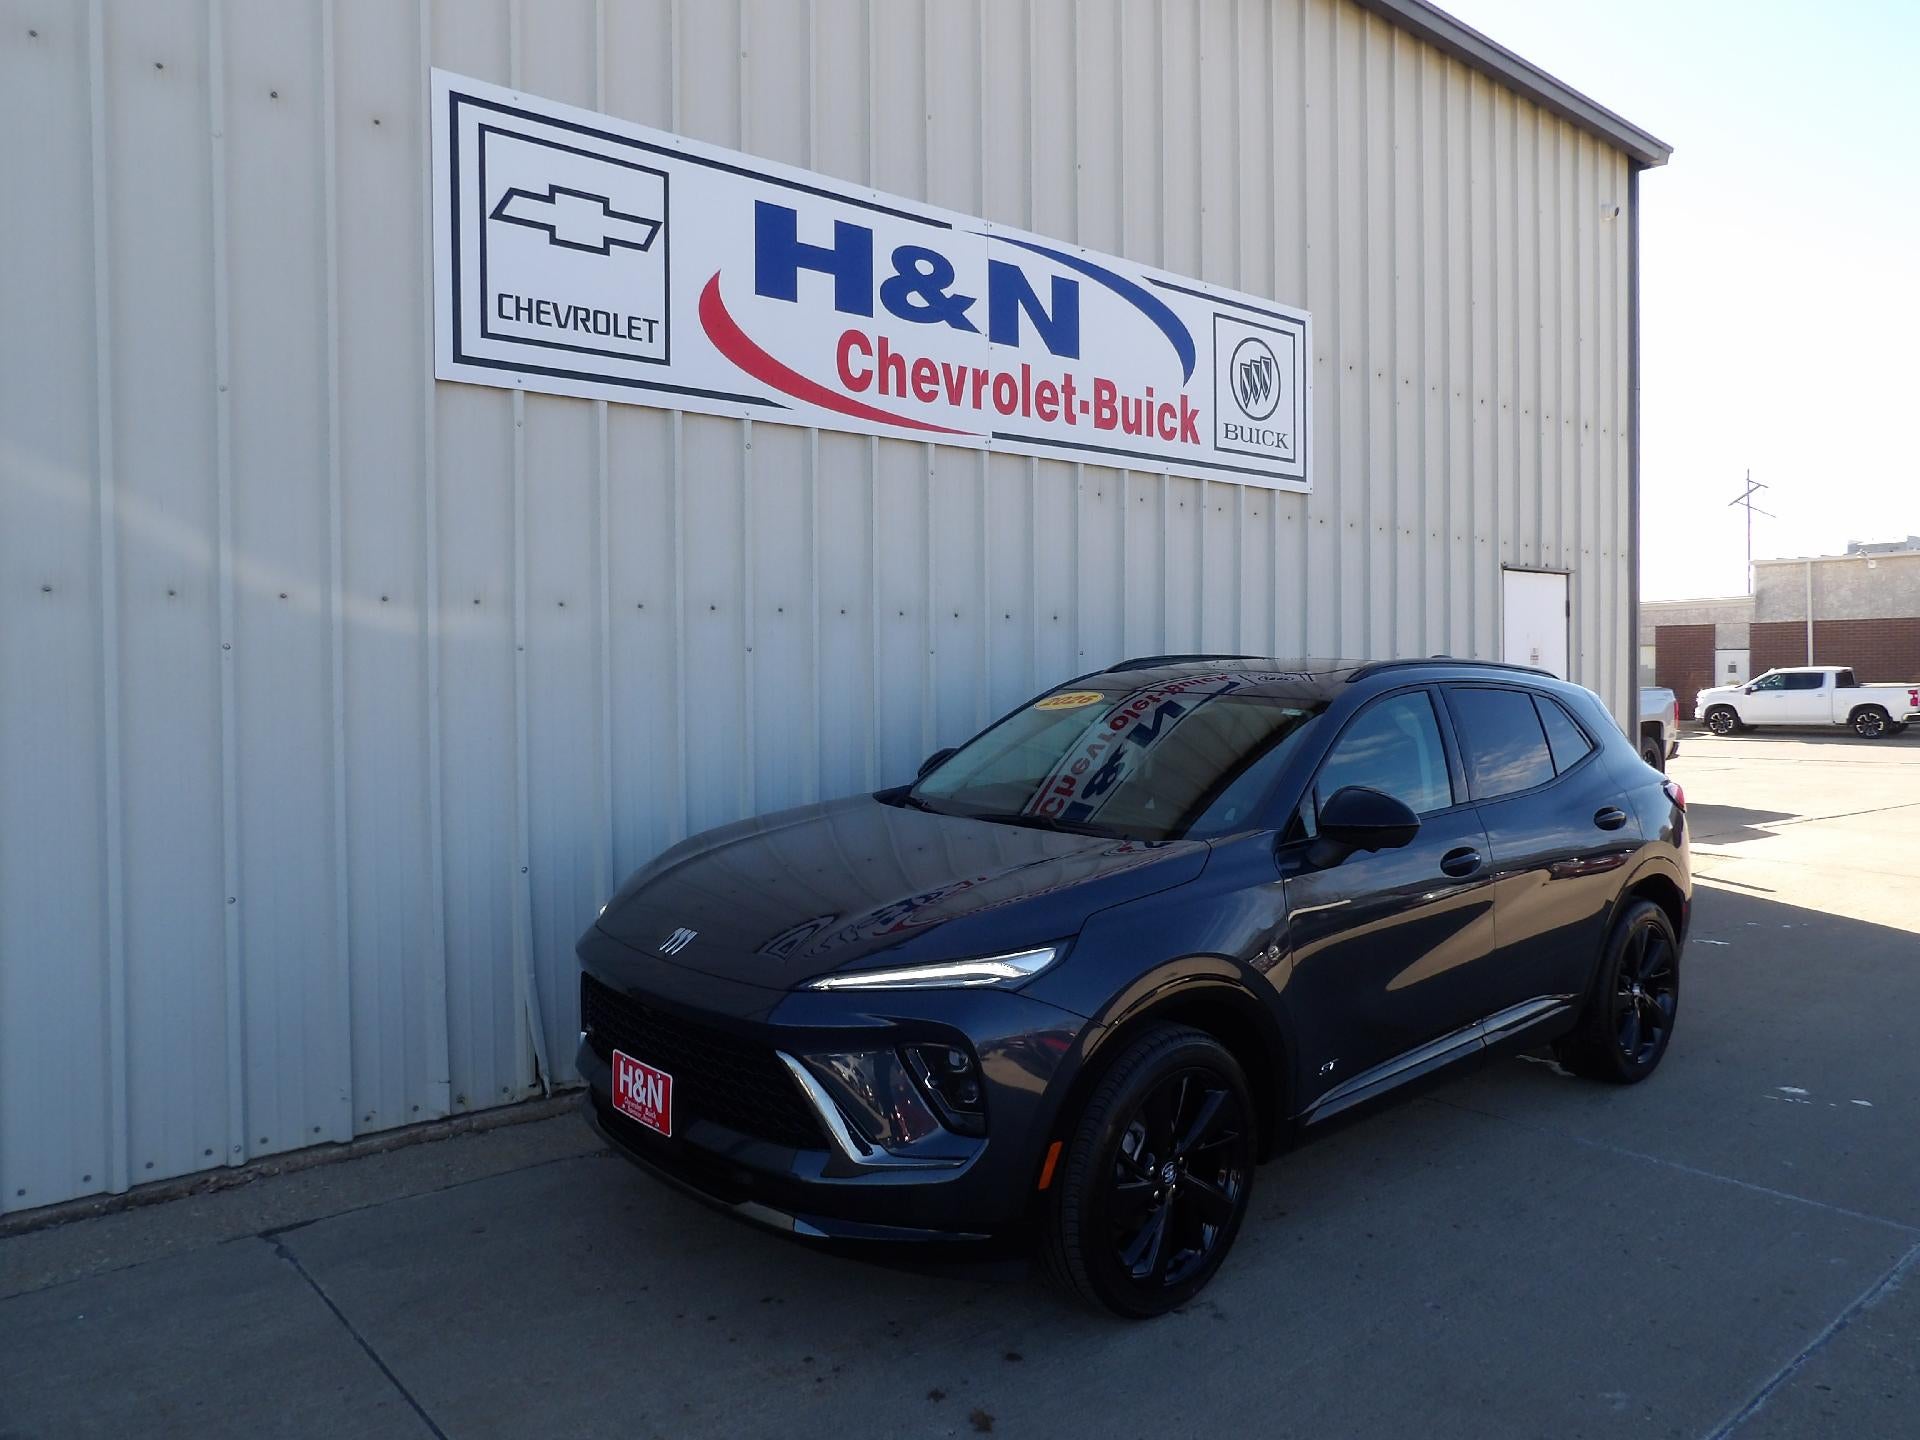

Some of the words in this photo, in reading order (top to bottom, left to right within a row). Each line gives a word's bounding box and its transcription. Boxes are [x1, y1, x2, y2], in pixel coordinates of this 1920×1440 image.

[754, 199, 1080, 360] H&N
[497, 293, 659, 344] CHEVROLET
[836, 329, 1200, 445] Chevrolet-Buick
[1223, 422, 1289, 450] BUICK
[619, 1060, 664, 1115] H&N
